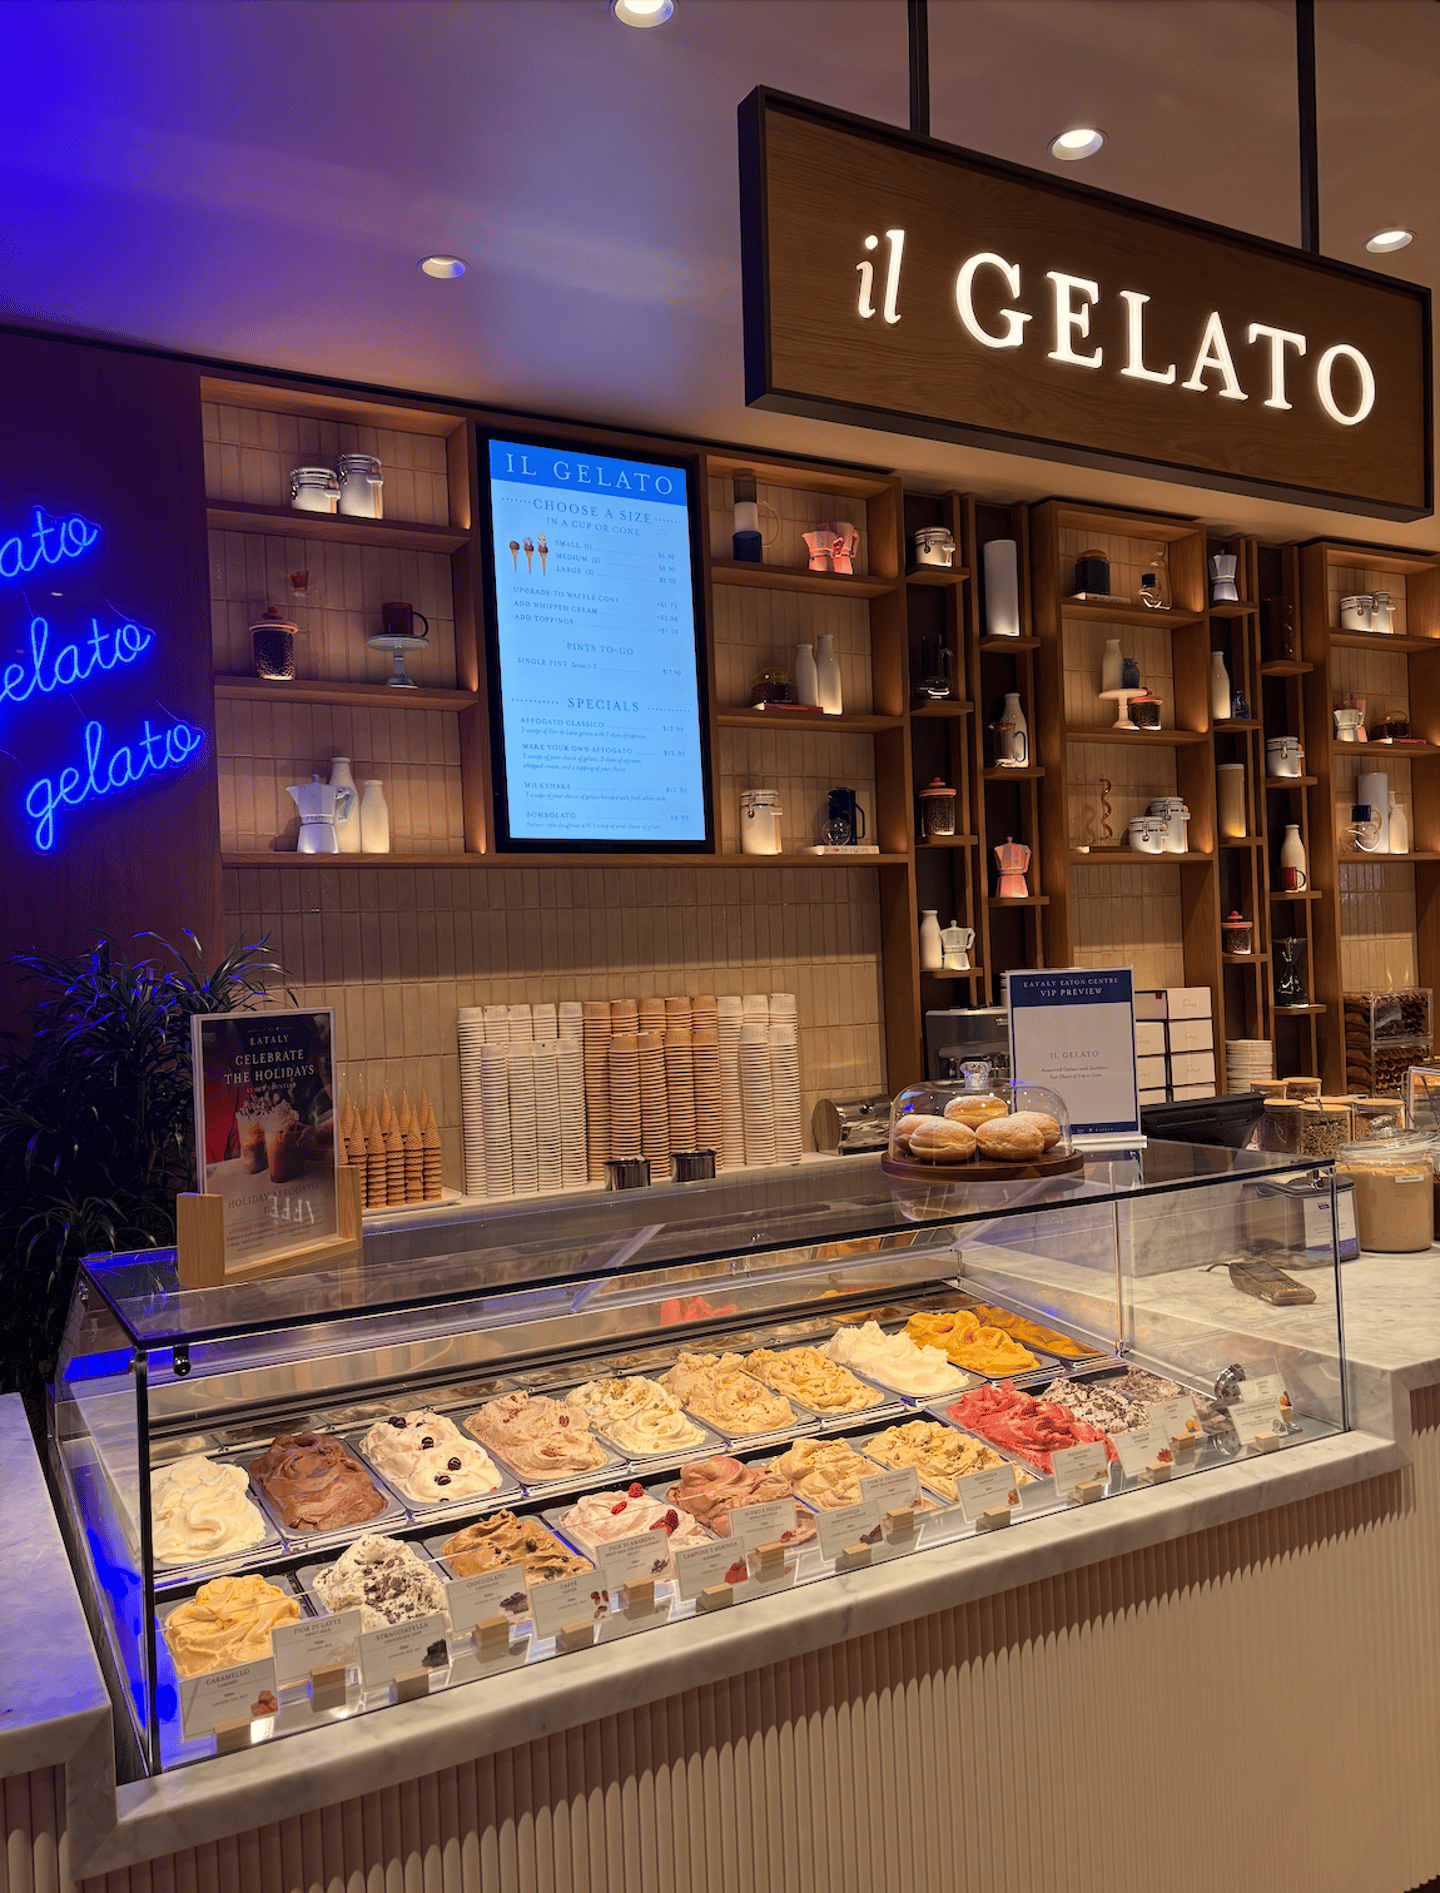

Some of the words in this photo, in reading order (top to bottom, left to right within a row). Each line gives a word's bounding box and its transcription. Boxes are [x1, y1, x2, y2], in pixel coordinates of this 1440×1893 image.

[856, 228, 905, 326] il
[953, 251, 1376, 427] GELATO
[505, 452, 537, 477] IL
[553, 459, 673, 496] GELATO
[533, 497, 598, 518] CHOOSE
[604, 508, 614, 520] A
[620, 510, 651, 525] SIZE
[546, 516, 558, 526] IN
[561, 518, 568, 528] A
[572, 520, 592, 530] CUP
[595, 522, 610, 533] OR
[612, 524, 640, 537] CONE
[556, 540, 580, 550] SMALL
[556, 552, 588, 562] MEDIUM
[556, 565, 582, 575] LARGE
[513, 586, 550, 597] UPGRADE
[554, 590, 565, 598] TO
[566, 592, 596, 602] WAFFLE
[598, 594, 620, 604] CONE
[514, 600, 531, 608] ADD
[533, 602, 569, 612] WHIPPED
[572, 605, 598, 615] CREAM
[514, 614, 532, 622] ADD
[534, 615, 574, 626] TOPPINGS
[566, 642, 596, 653] PINTS
[599, 644, 634, 656] TO-GO
[516, 656, 546, 667] SINGLE
[549, 659, 568, 668] PINT
[567, 696, 640, 713] SPECIALS
[520, 716, 564, 726] AFFOGATO
[566, 719, 605, 729] CLASSICO
[522, 743, 545, 752] MAKE
[546, 744, 570, 752] YOUR
[572, 746, 590, 754] OWN
[592, 746, 633, 756] AFFOGATO
[25, 720, 201, 851] gelato
[524, 782, 572, 790] MILKSHAKE
[526, 811, 577, 820] BOMBOLATO
[1023, 980, 1057, 989] EATALY
[1060, 978, 1086, 988] EATON
[1088, 977, 1119, 986] CENTRE
[1040, 988, 1058, 998] VIP
[1060, 987, 1104, 997] PREVIEW
[250, 1033, 290, 1046] EATALY
[234, 1048, 305, 1067] CELEBRATE
[1050, 1052, 1060, 1060] IL
[1062, 1050, 1100, 1060] GELATO
[224, 1070, 250, 1086] THE
[254, 1064, 316, 1082] HOLIDAYS
[228, 1192, 270, 1210] HOLIDAY
[274, 1182, 319, 1199] AFFOGATO
[466, 1572, 507, 1589] CIOCCOLATO
[293, 1626, 310, 1636] FIOR
[311, 1622, 320, 1631] DI
[320, 1618, 342, 1629] LATTE
[376, 1622, 430, 1642] STRACCIATELLA
[206, 1668, 251, 1686] CARAMELLO
